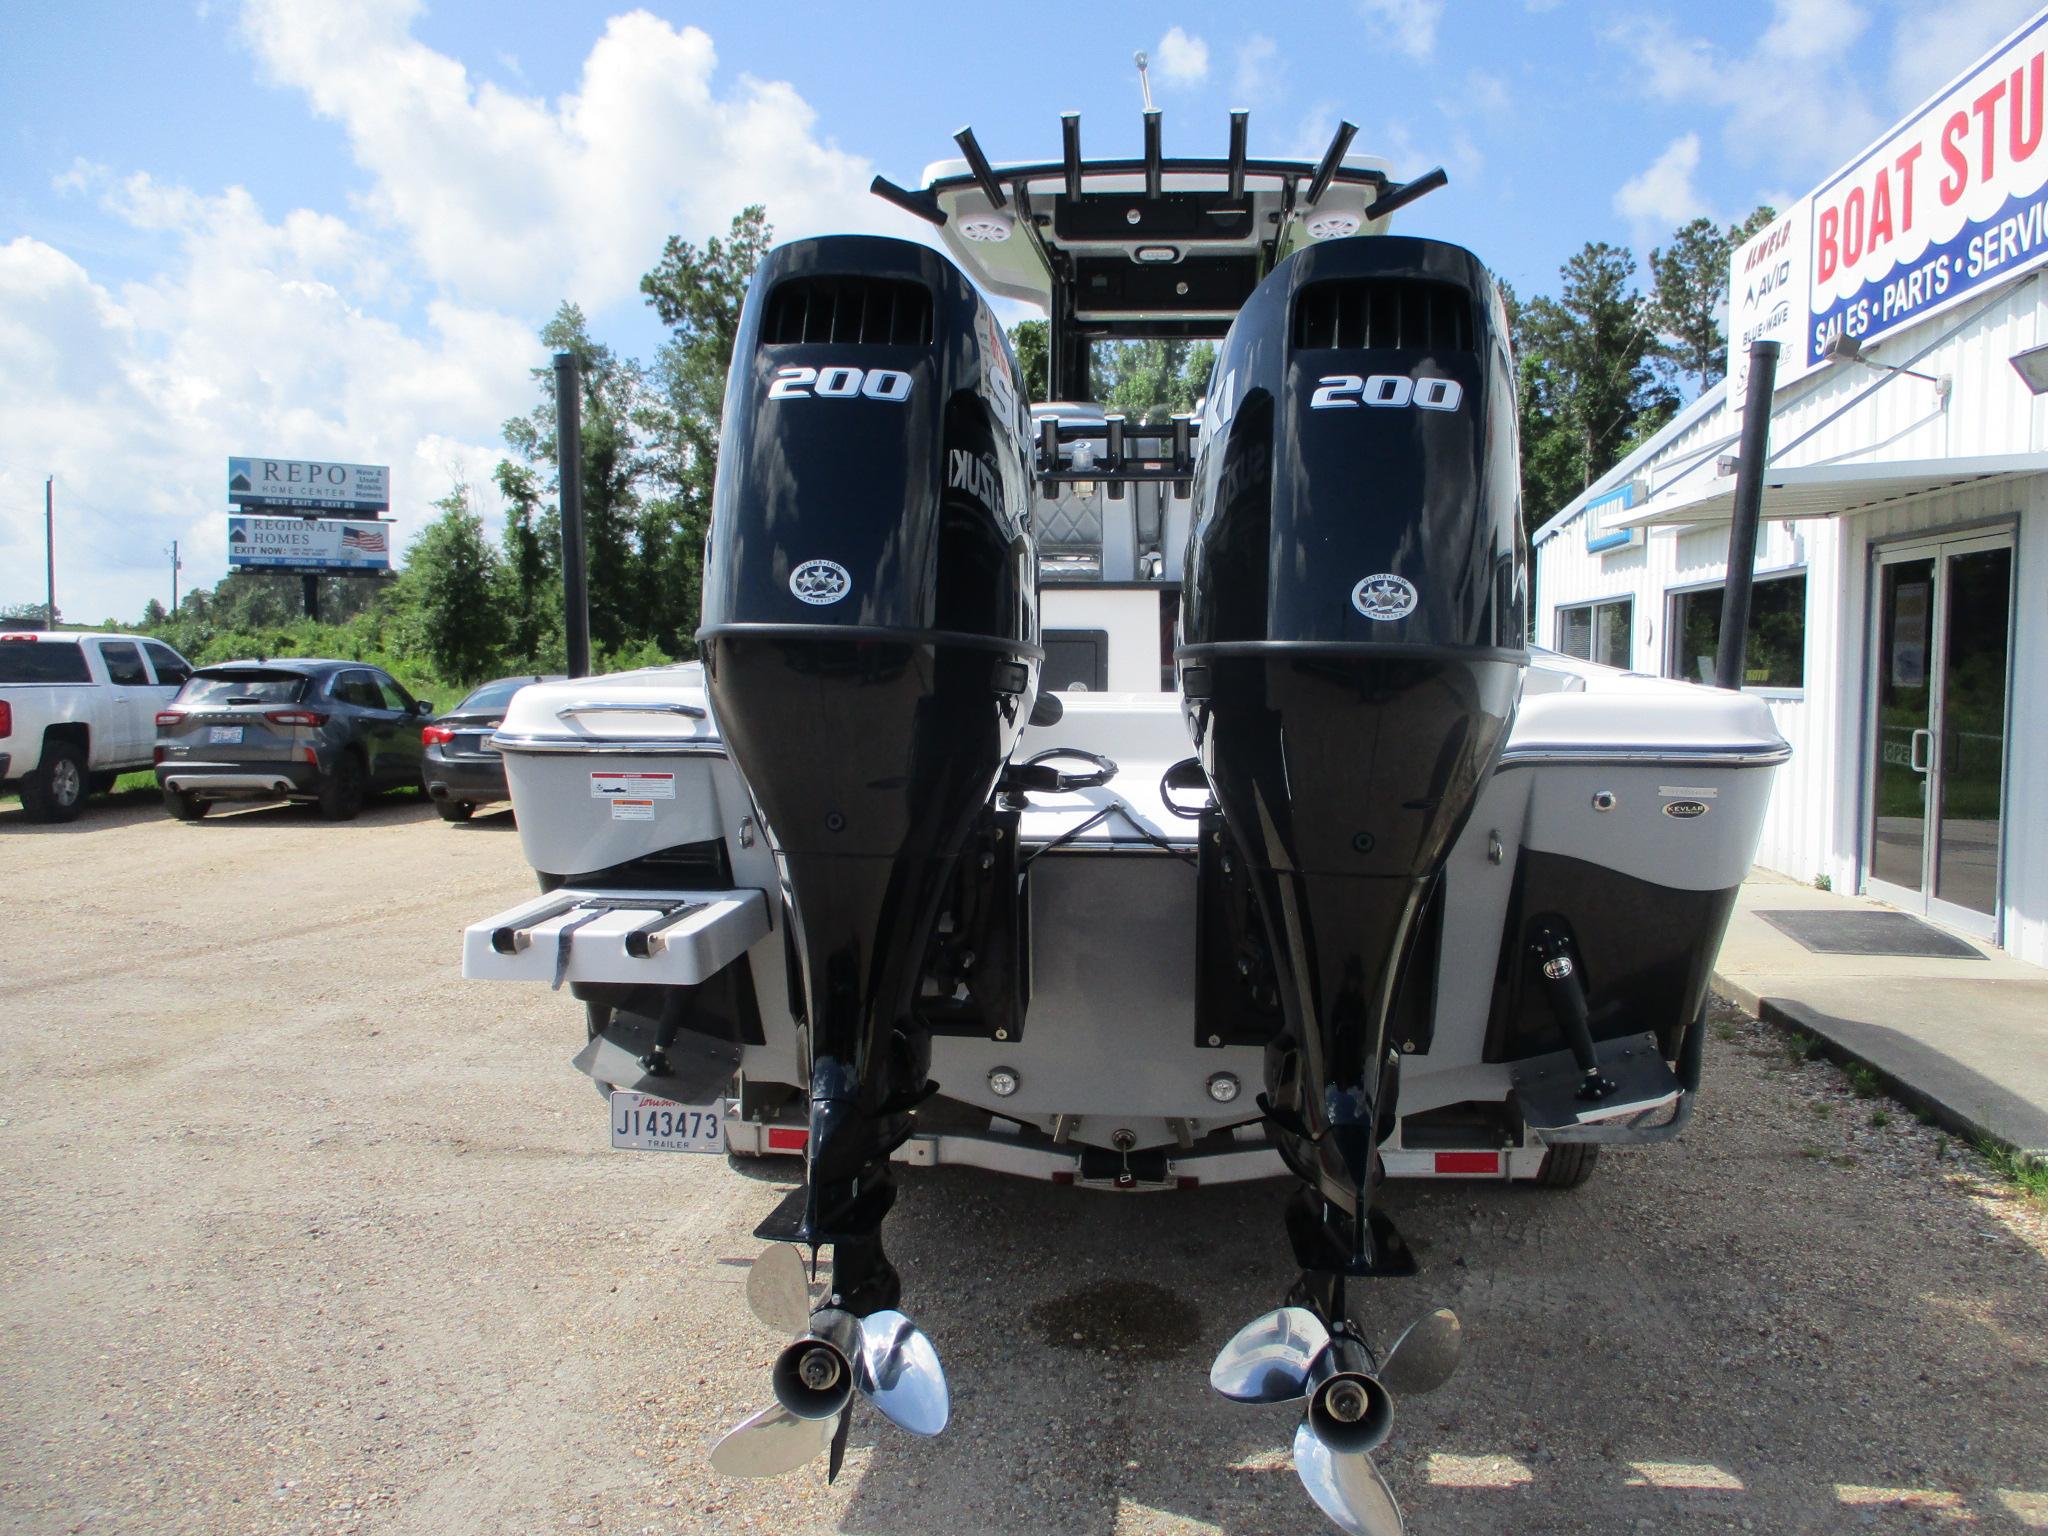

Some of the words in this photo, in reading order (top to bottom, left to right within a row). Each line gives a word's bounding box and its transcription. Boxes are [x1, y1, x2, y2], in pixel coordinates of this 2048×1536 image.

[1818, 141, 1922, 286] BOAT
[1882, 255, 1950, 322] PARTS
[1967, 200, 2048, 278] SERVI
[1755, 259, 1790, 310] AVID
[1743, 321, 1763, 347] BLUE
[1766, 307, 1789, 334] WAVE
[768, 366, 914, 402] 200
[1310, 375, 1464, 412] 200
[262, 461, 347, 485] REPO
[262, 485, 295, 495] HOME
[300, 487, 346, 497] CENTER
[320, 500, 341, 508] EXIT
[254, 519, 337, 533] REGIONAL
[234, 546, 256, 555] EXIT
[260, 547, 287, 555] NOW:
[254, 533, 310, 545] HOMES
[1667, 804, 1705, 812] KEVLAR
[616, 1109, 718, 1139] J143473
[647, 1139, 690, 1149] TRAILER
